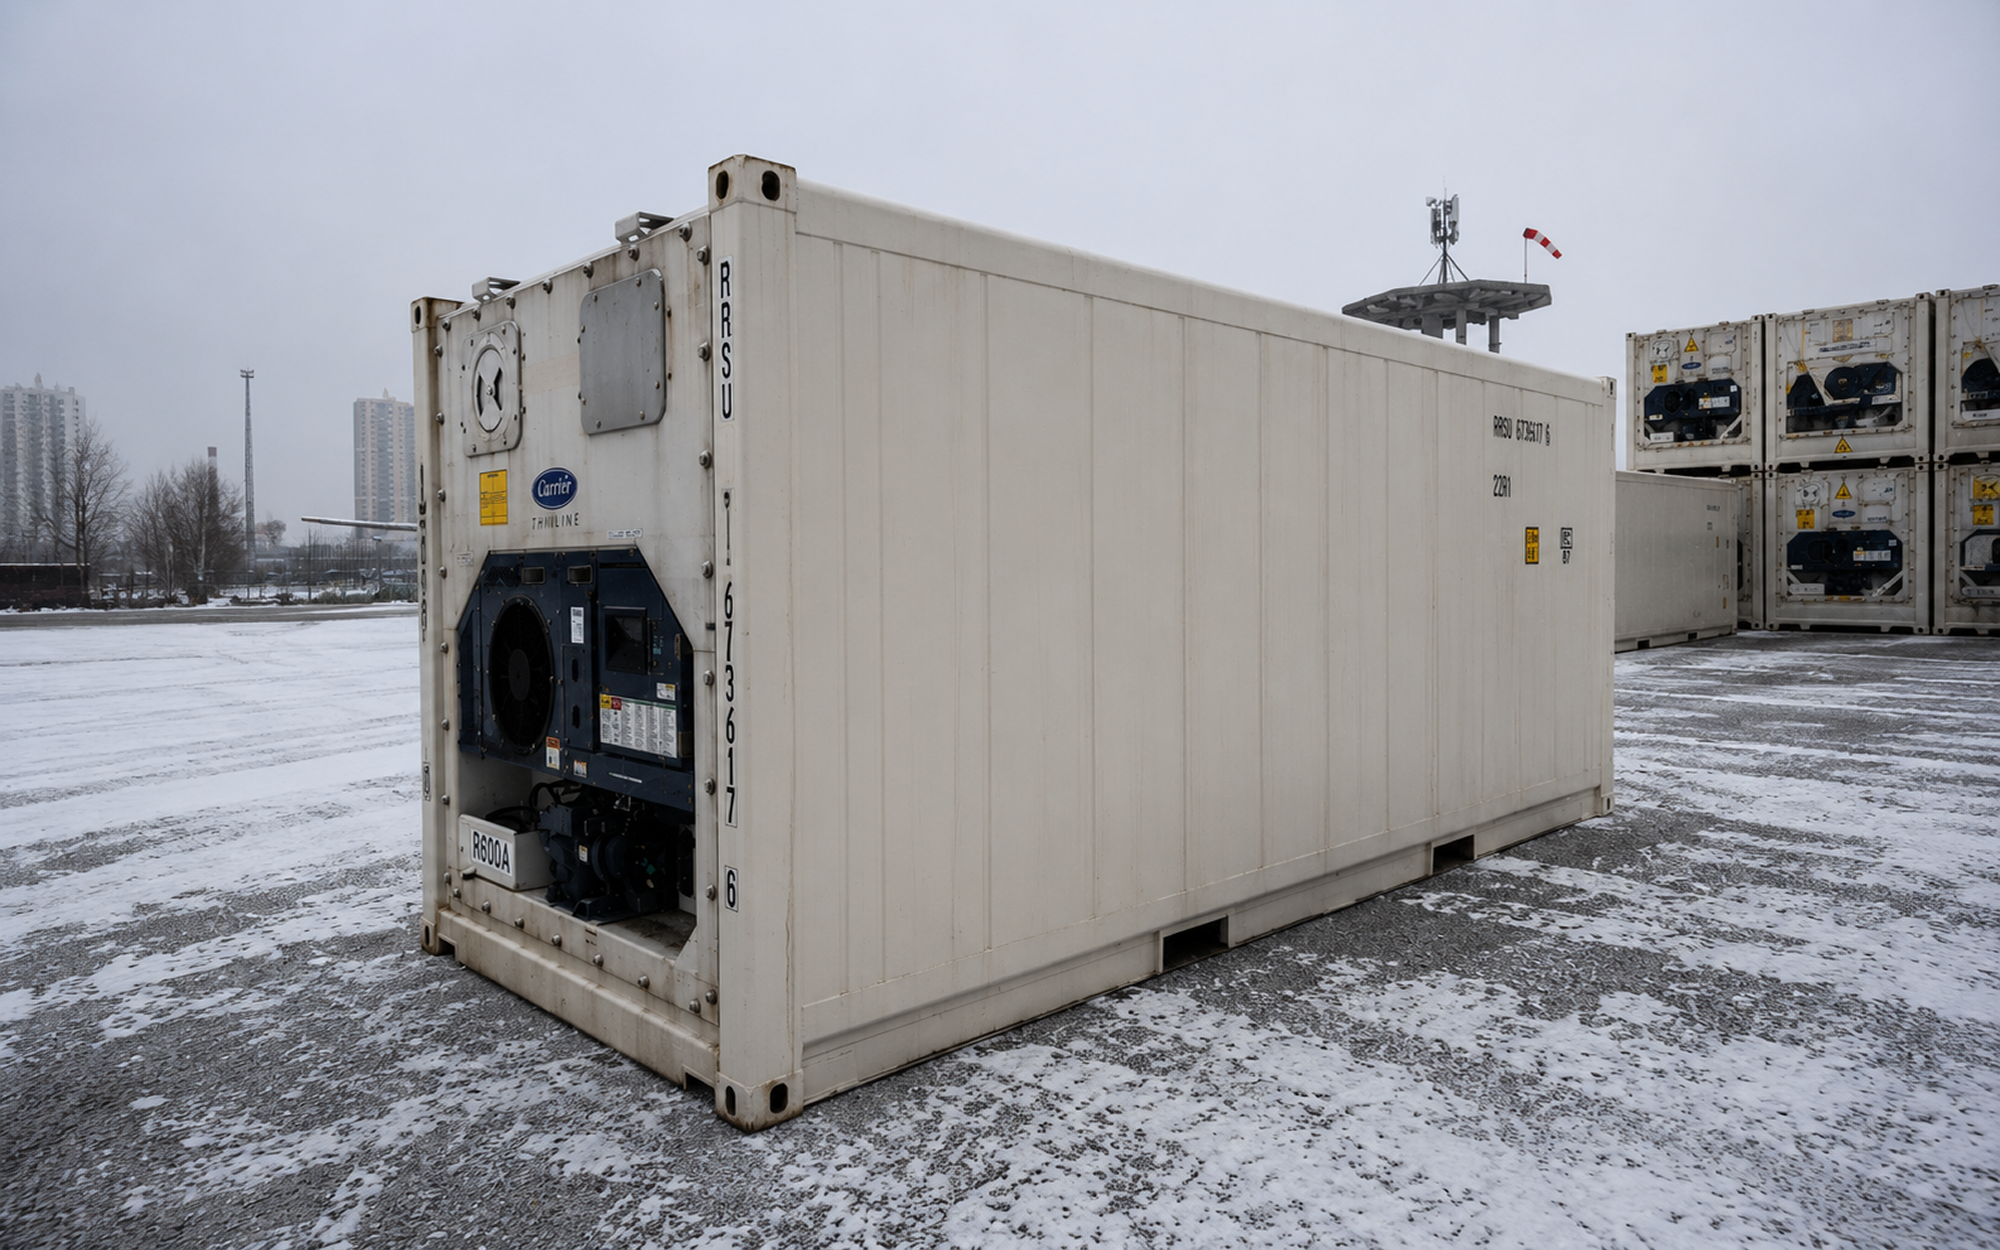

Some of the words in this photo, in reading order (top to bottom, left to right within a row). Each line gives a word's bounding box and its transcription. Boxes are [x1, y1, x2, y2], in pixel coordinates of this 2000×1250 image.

[720, 261, 732, 419] RRSU
[1493, 415, 1512, 438] RRSU
[538, 475, 572, 497] Carrier
[724, 581, 735, 823] 673617
[473, 831, 510, 873] R600A
[727, 869, 735, 908] 6
